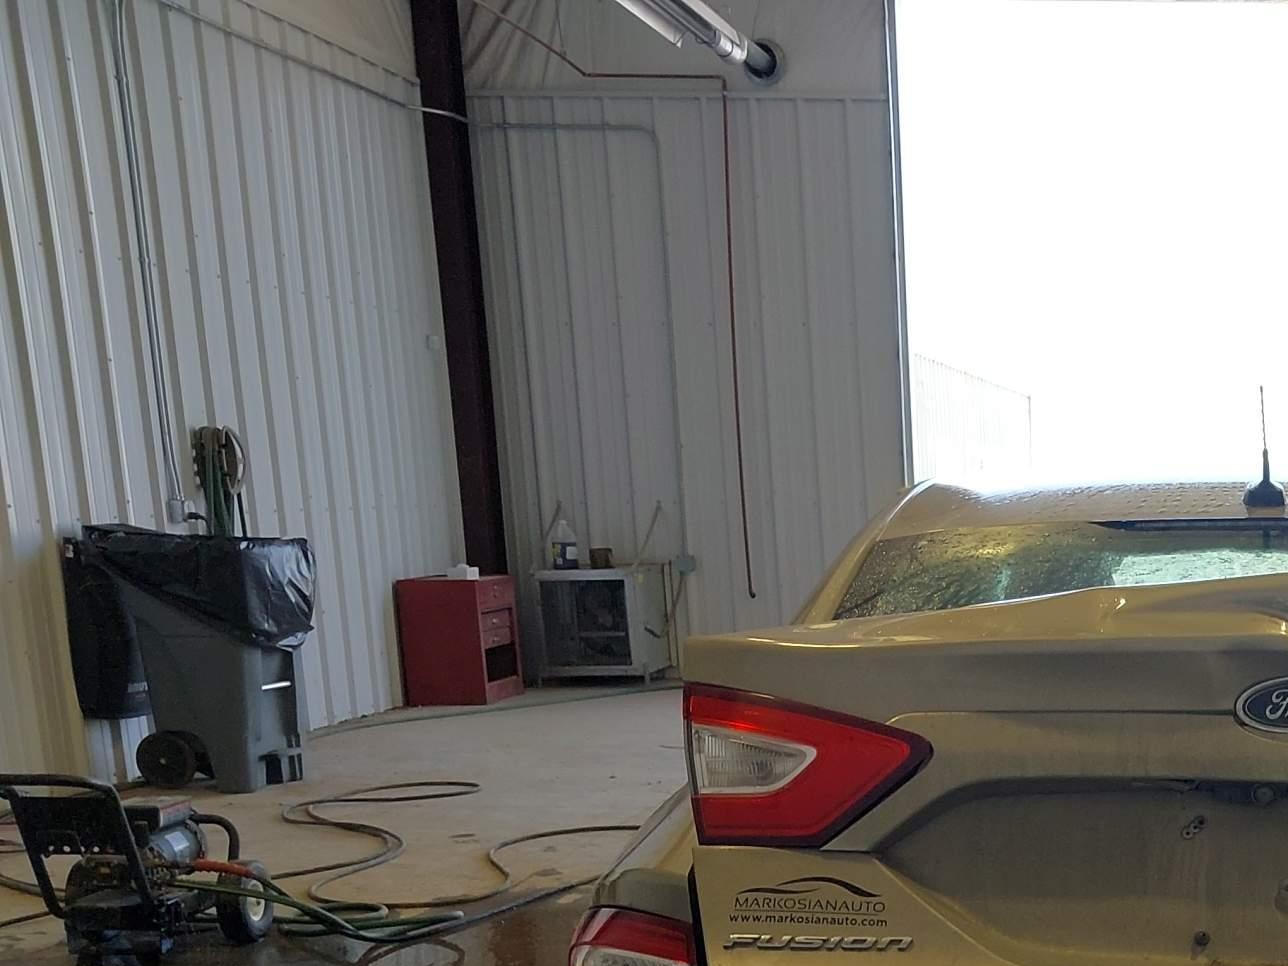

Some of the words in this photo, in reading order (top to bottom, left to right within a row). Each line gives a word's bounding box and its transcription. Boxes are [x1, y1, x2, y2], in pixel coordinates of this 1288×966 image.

[734, 896, 886, 913] MARKOSIANAUTO
[729, 912, 888, 927] www.markosianauto.com
[723, 934, 914, 951] FUSION
